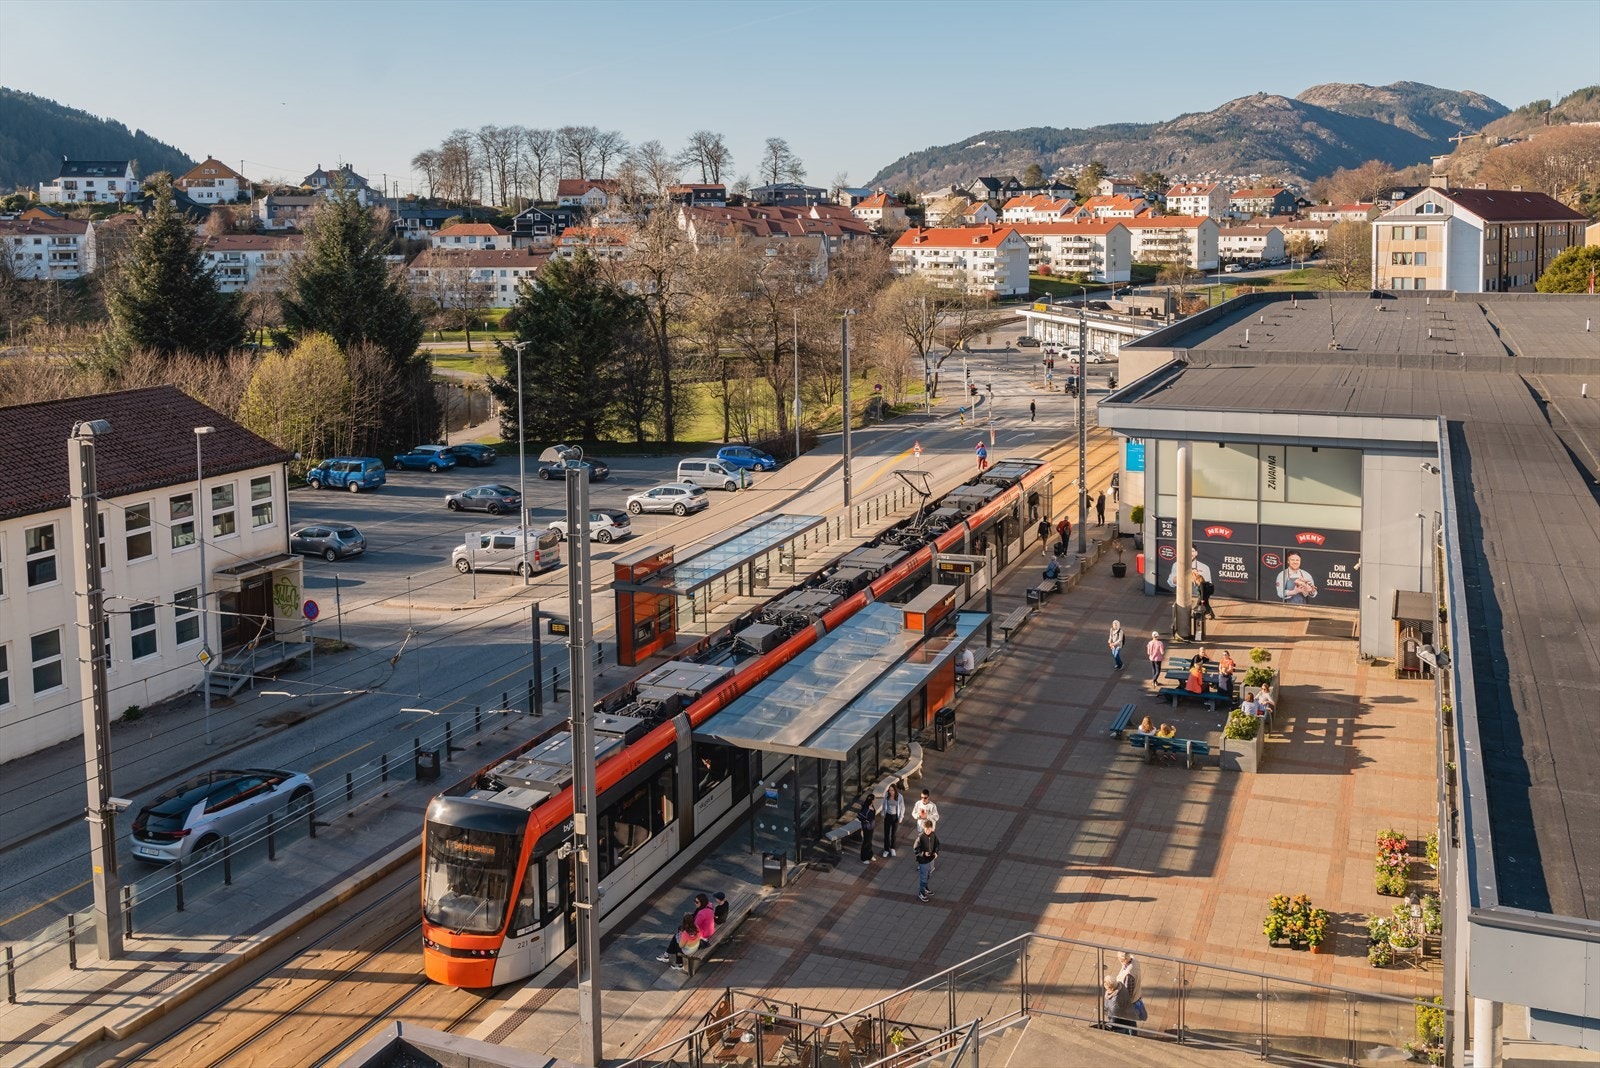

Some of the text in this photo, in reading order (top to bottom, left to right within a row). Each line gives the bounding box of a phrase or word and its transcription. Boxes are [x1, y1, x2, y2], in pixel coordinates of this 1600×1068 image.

[1267, 455, 1277, 490] ZAVANNA
[1207, 527, 1230, 536] MENY
[1299, 534, 1323, 543] MENY
[1224, 556, 1243, 564] FERSK
[1222, 563, 1236, 571] FISK
[1333, 564, 1346, 572] DIN
[1218, 571, 1249, 579] SKALLDYR
[1328, 572, 1351, 580] LOKALE
[1326, 580, 1353, 588] SLAKTER
[454, 841, 473, 852] Bergen
[473, 845, 496, 855] sentrum
[517, 940, 528, 949] 221
